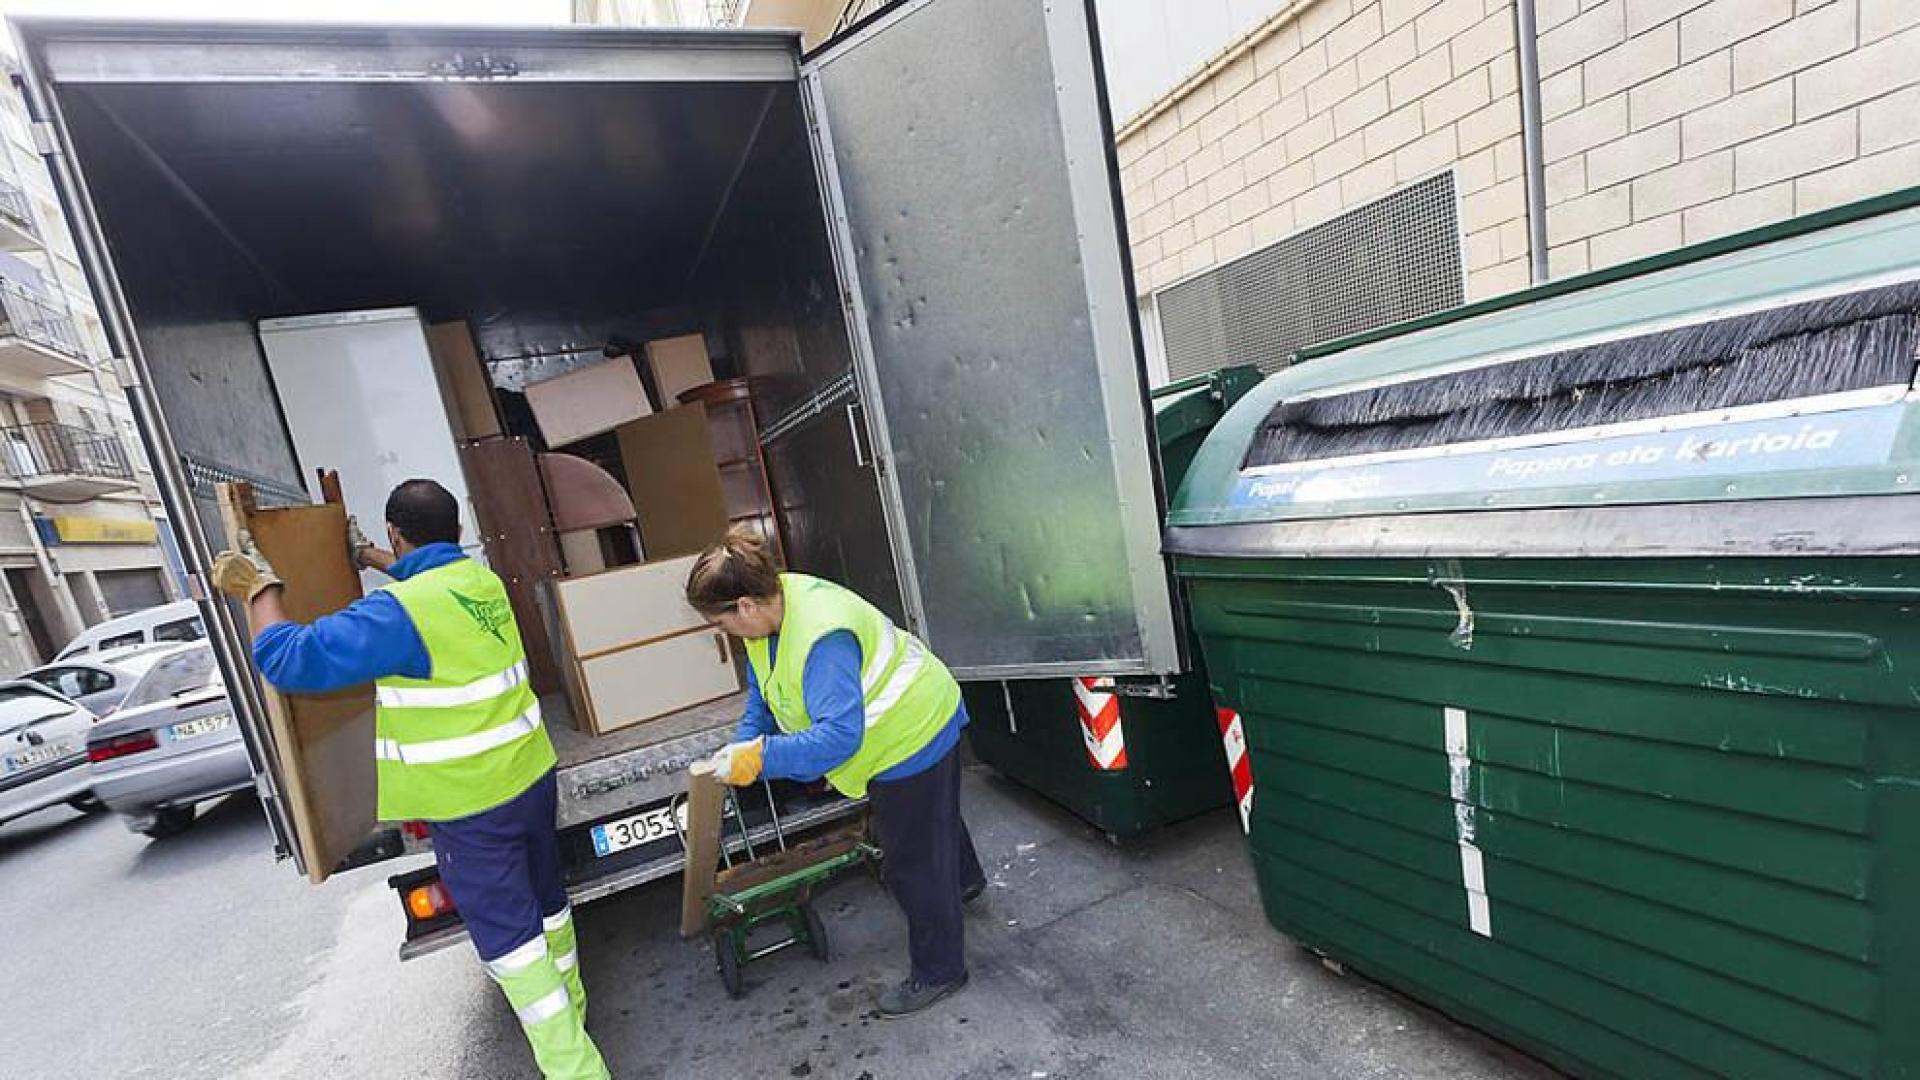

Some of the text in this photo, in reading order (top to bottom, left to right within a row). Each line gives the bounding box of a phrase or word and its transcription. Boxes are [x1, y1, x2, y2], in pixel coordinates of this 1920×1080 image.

[1488, 425, 1840, 478] Papera eta kartoia
